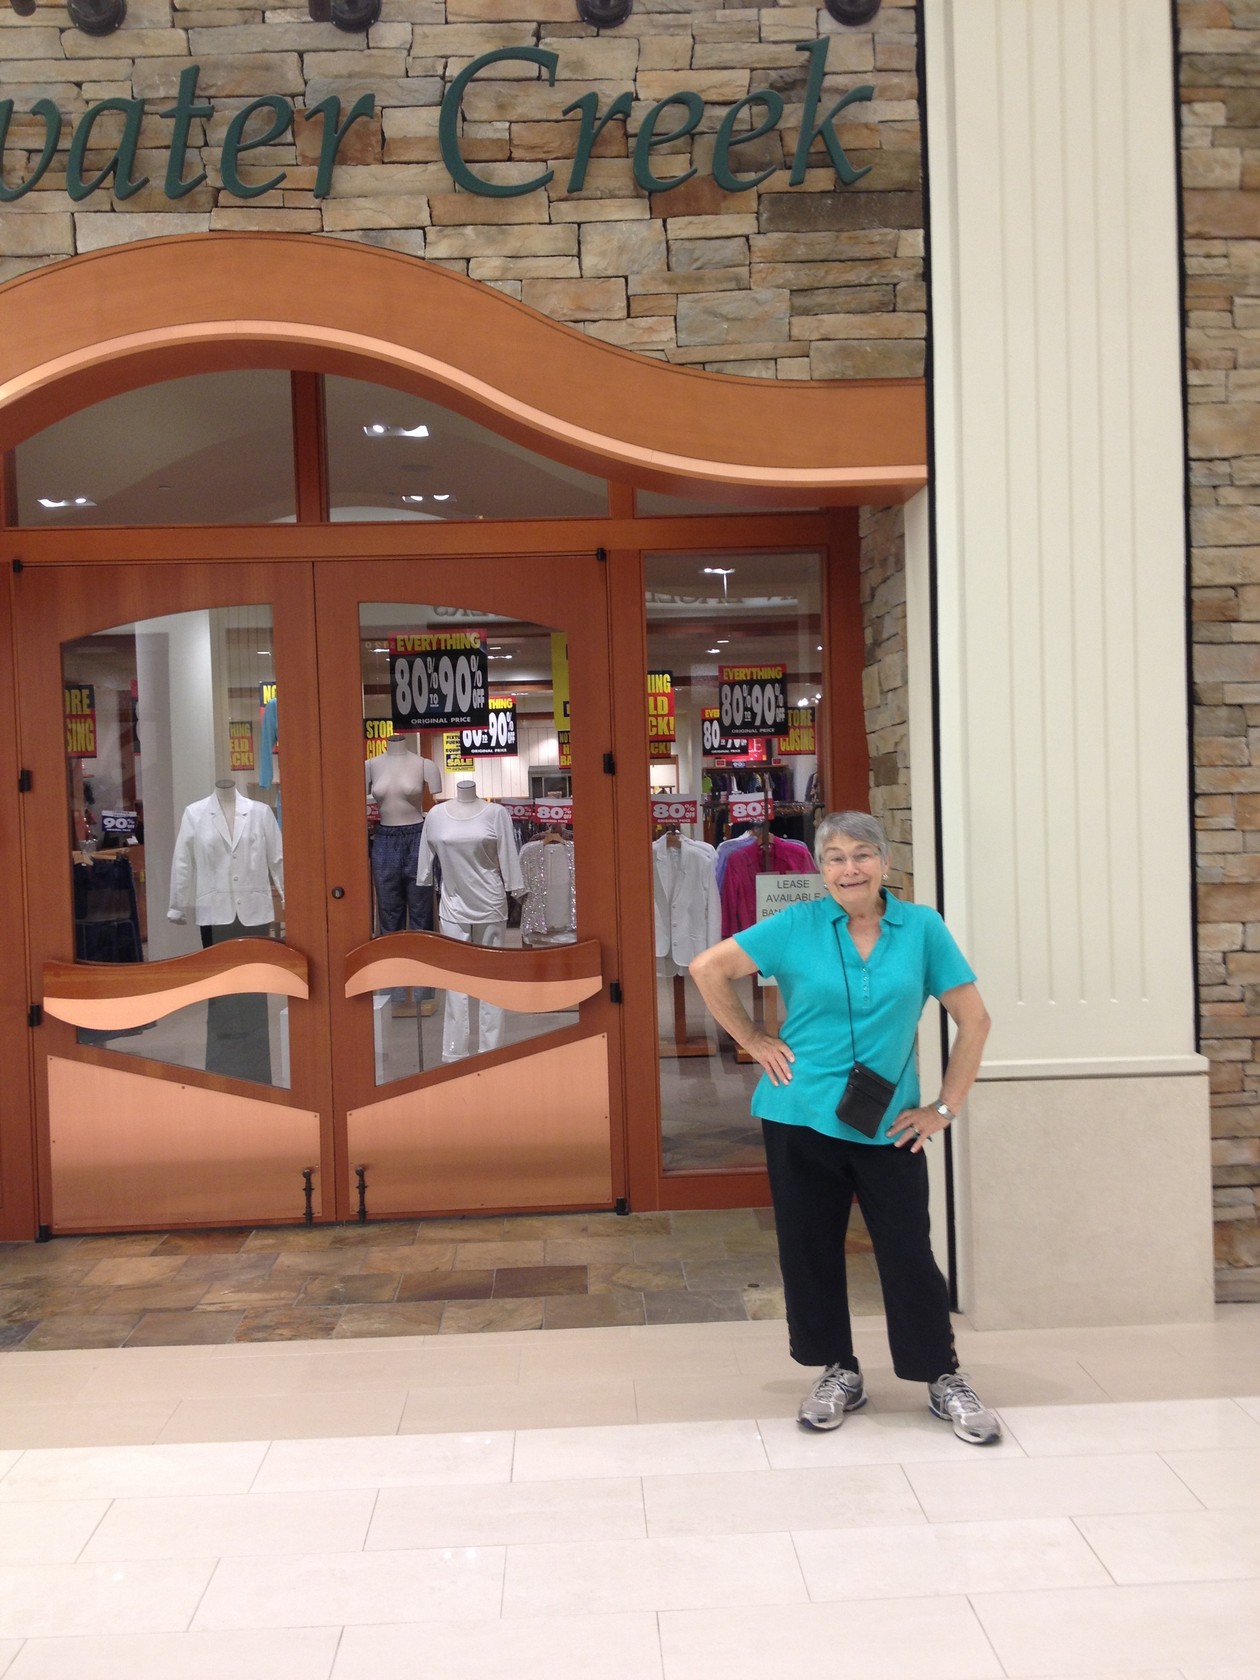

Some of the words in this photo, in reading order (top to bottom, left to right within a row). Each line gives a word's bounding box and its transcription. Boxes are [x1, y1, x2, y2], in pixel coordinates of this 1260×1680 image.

[438, 36, 875, 198] Creek
[396, 633, 480, 651] EVERYTHING
[722, 667, 783, 680] EVERYTHING
[395, 655, 439, 715] 80%
[429, 694, 440, 708] TO
[439, 655, 483, 713] 90%
[472, 689, 485, 709] OFF
[721, 684, 751, 726] 80%
[751, 683, 784, 726] 90%
[447, 758, 473, 766] SALE
[653, 803, 696, 818] 80%
[777, 879, 810, 889] LEASE
[766, 893, 821, 903] AVAILABLE
